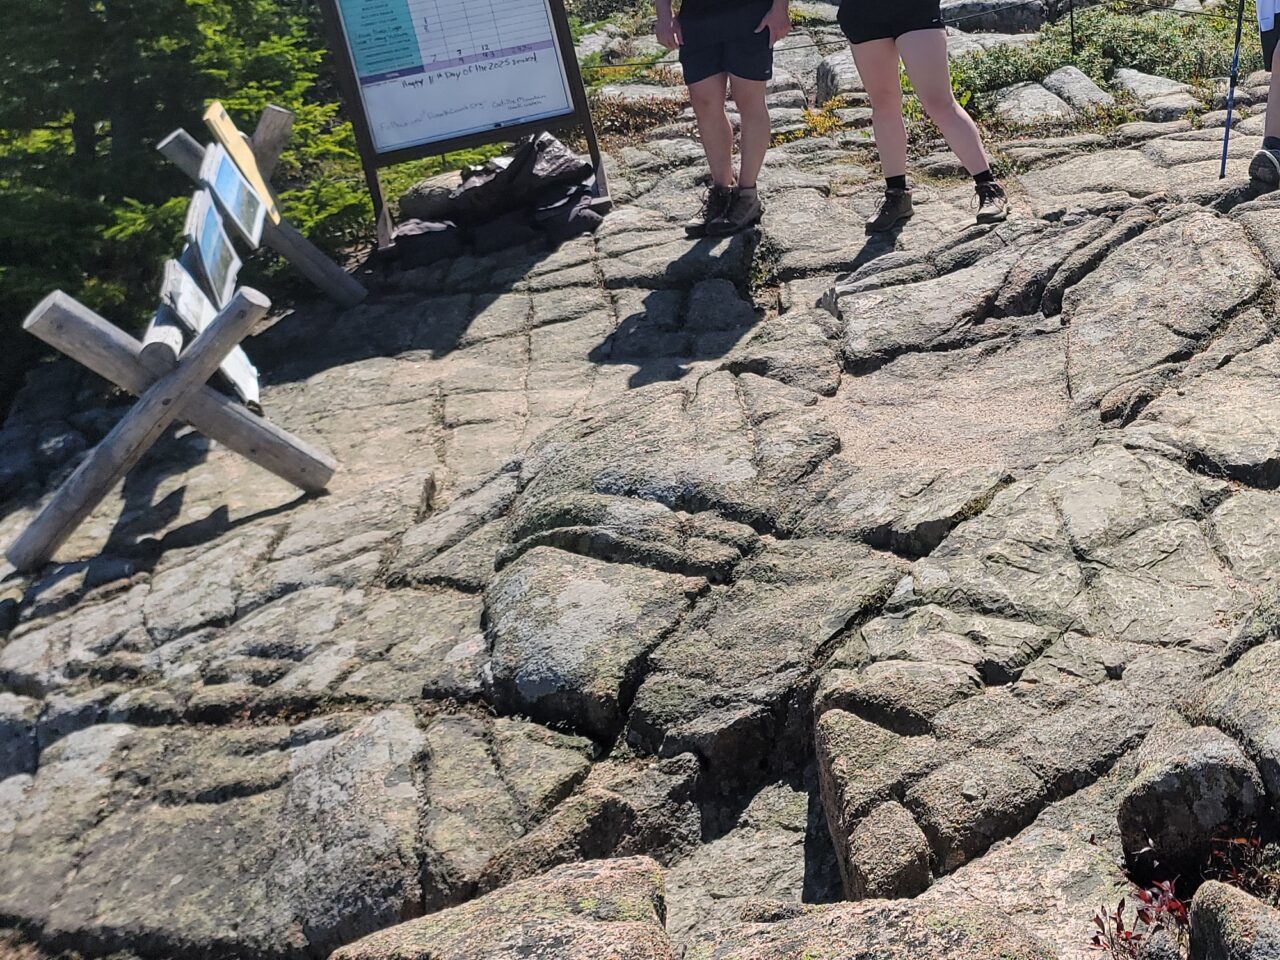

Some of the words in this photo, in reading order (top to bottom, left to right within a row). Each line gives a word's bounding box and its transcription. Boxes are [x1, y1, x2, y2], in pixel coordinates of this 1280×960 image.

[401, 79, 424, 89] Happy
[445, 71, 461, 81] Day
[463, 65, 473, 76] of
[475, 63, 487, 73] the
[488, 58, 511, 71] 2025
